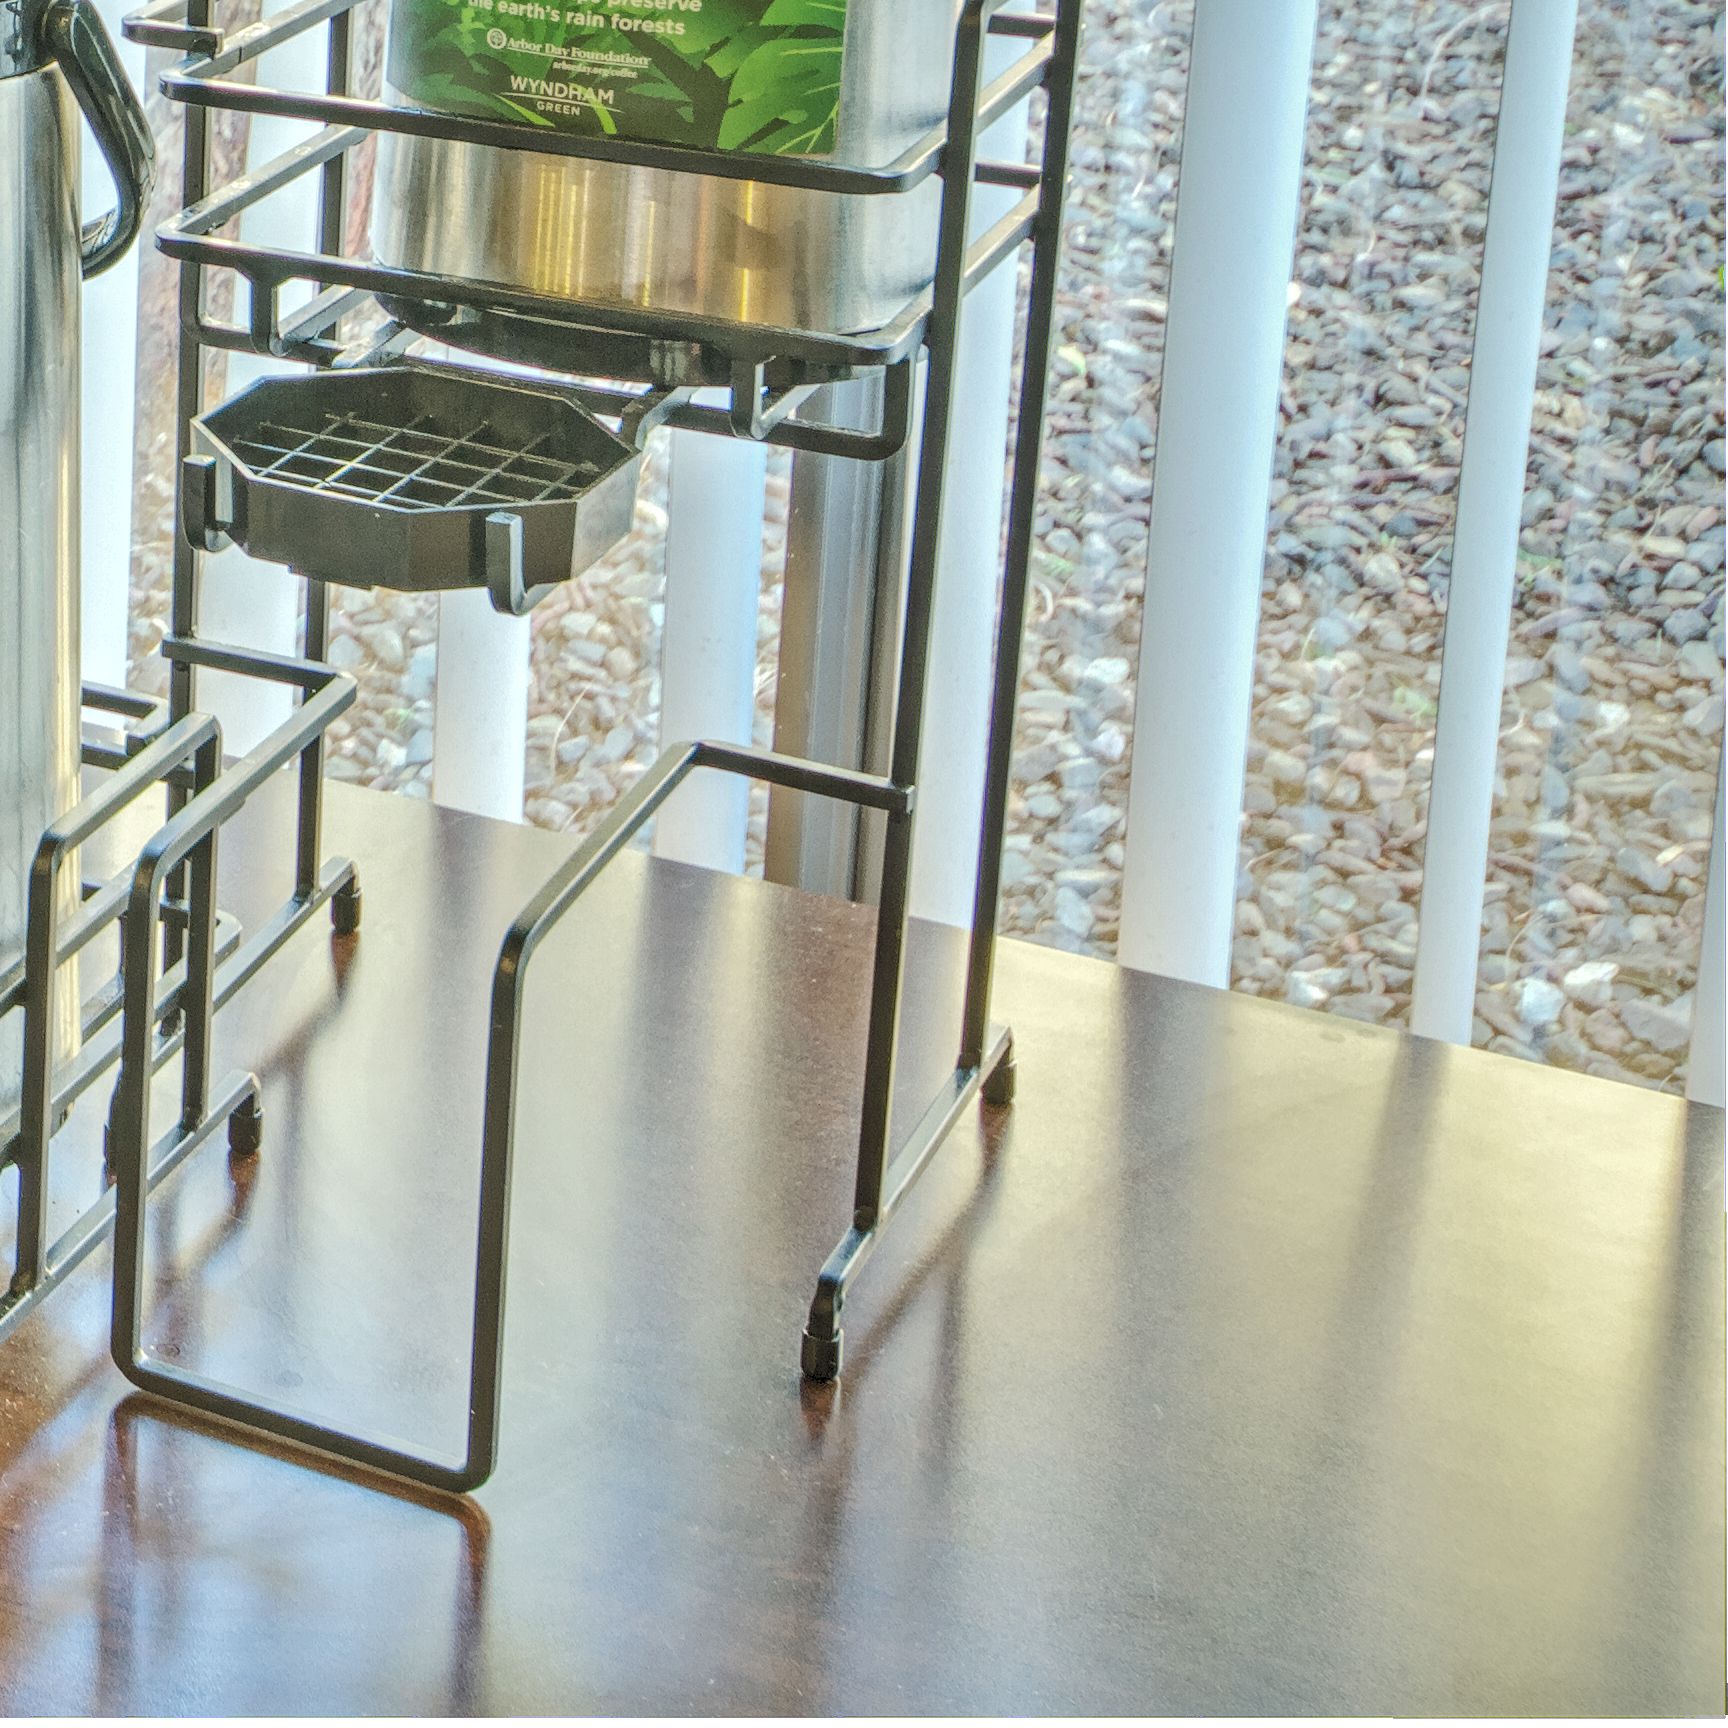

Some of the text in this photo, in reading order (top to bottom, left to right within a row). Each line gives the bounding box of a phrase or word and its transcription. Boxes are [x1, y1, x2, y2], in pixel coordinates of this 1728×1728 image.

[566, 9, 604, 29] rain
[610, 12, 686, 36] forests
[507, 37, 542, 52] Arbor
[544, 43, 570, 57] Day
[510, 75, 614, 105] WYNDHAM
[536, 101, 581, 116] GREEN
